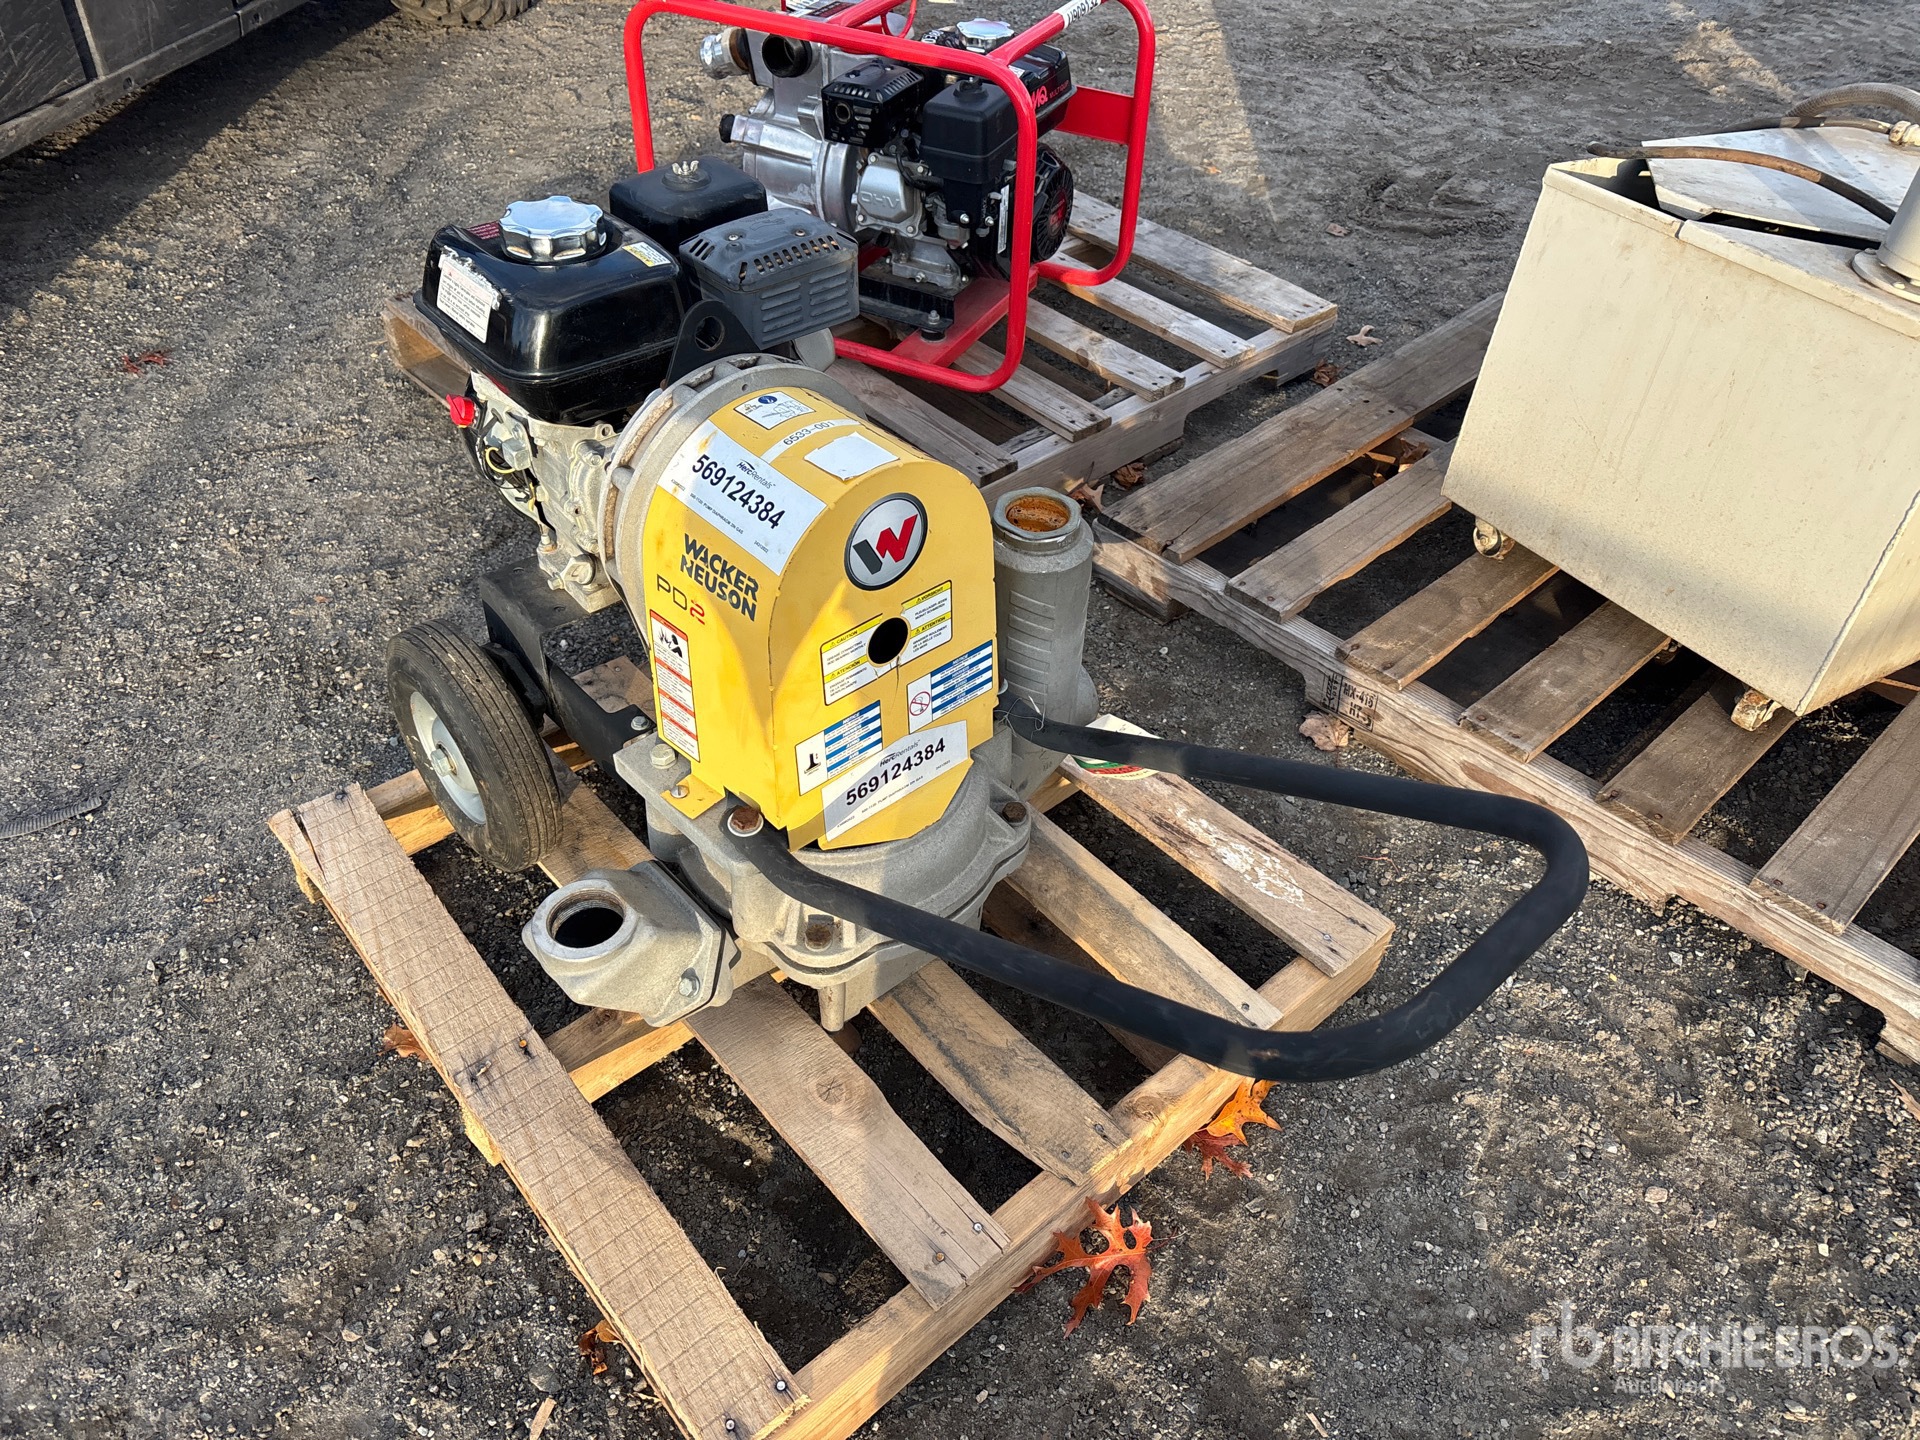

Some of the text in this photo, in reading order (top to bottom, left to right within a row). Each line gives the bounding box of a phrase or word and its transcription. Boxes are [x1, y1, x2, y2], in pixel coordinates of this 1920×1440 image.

[860, 190, 900, 209] OHV
[783, 421, 835, 446] 6533-001
[692, 454, 786, 529] 569124384
[680, 554, 757, 622] NEUSON
[685, 533, 759, 602] WACKER
[657, 574, 706, 625] PD2
[921, 616, 946, 631] ATTENTION
[836, 629, 858, 644] CAUTION
[846, 737, 946, 806] 569124384
